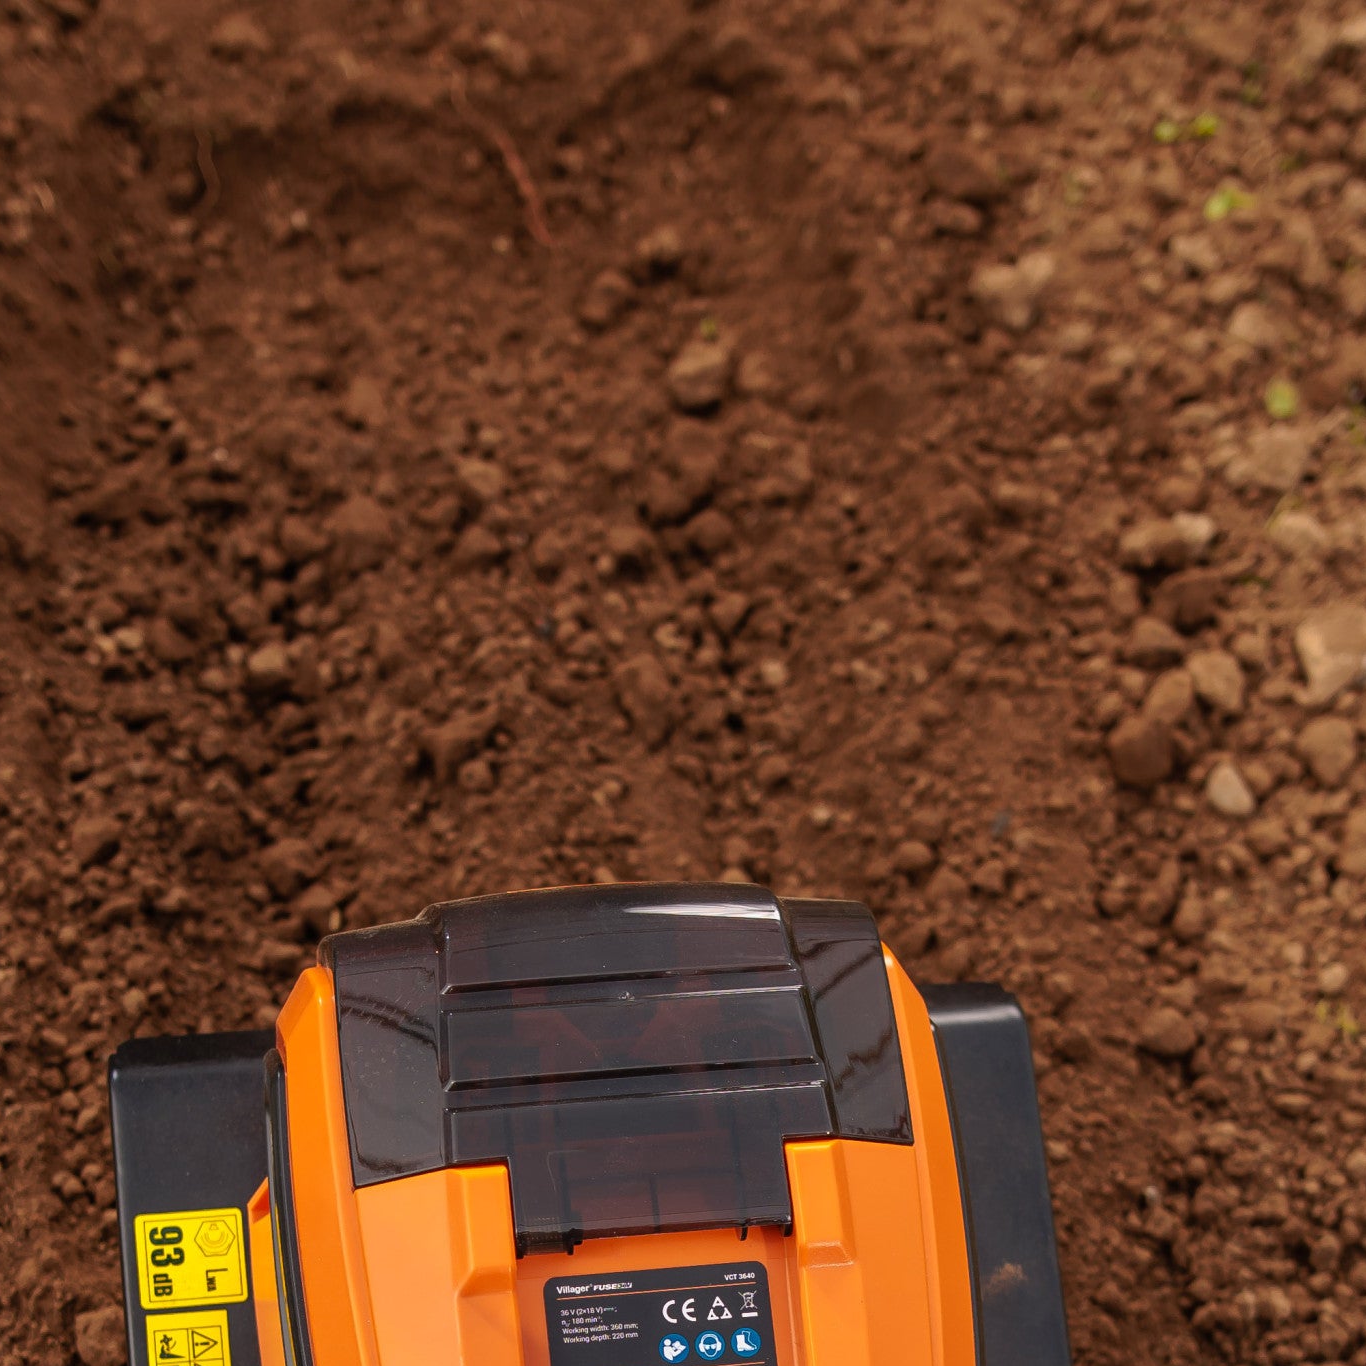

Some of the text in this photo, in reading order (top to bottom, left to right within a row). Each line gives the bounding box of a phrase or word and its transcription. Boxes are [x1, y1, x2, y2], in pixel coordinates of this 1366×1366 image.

[149, 1226, 184, 1297] 93 dB
[738, 1272, 755, 1280] 3640
[556, 1285, 589, 1294] Villager
[662, 1298, 697, 1324] CE
[562, 1326, 589, 1335] Working
[563, 1335, 590, 1344] Working
[590, 1334, 611, 1343] depth:
[612, 1332, 625, 1340] 220
